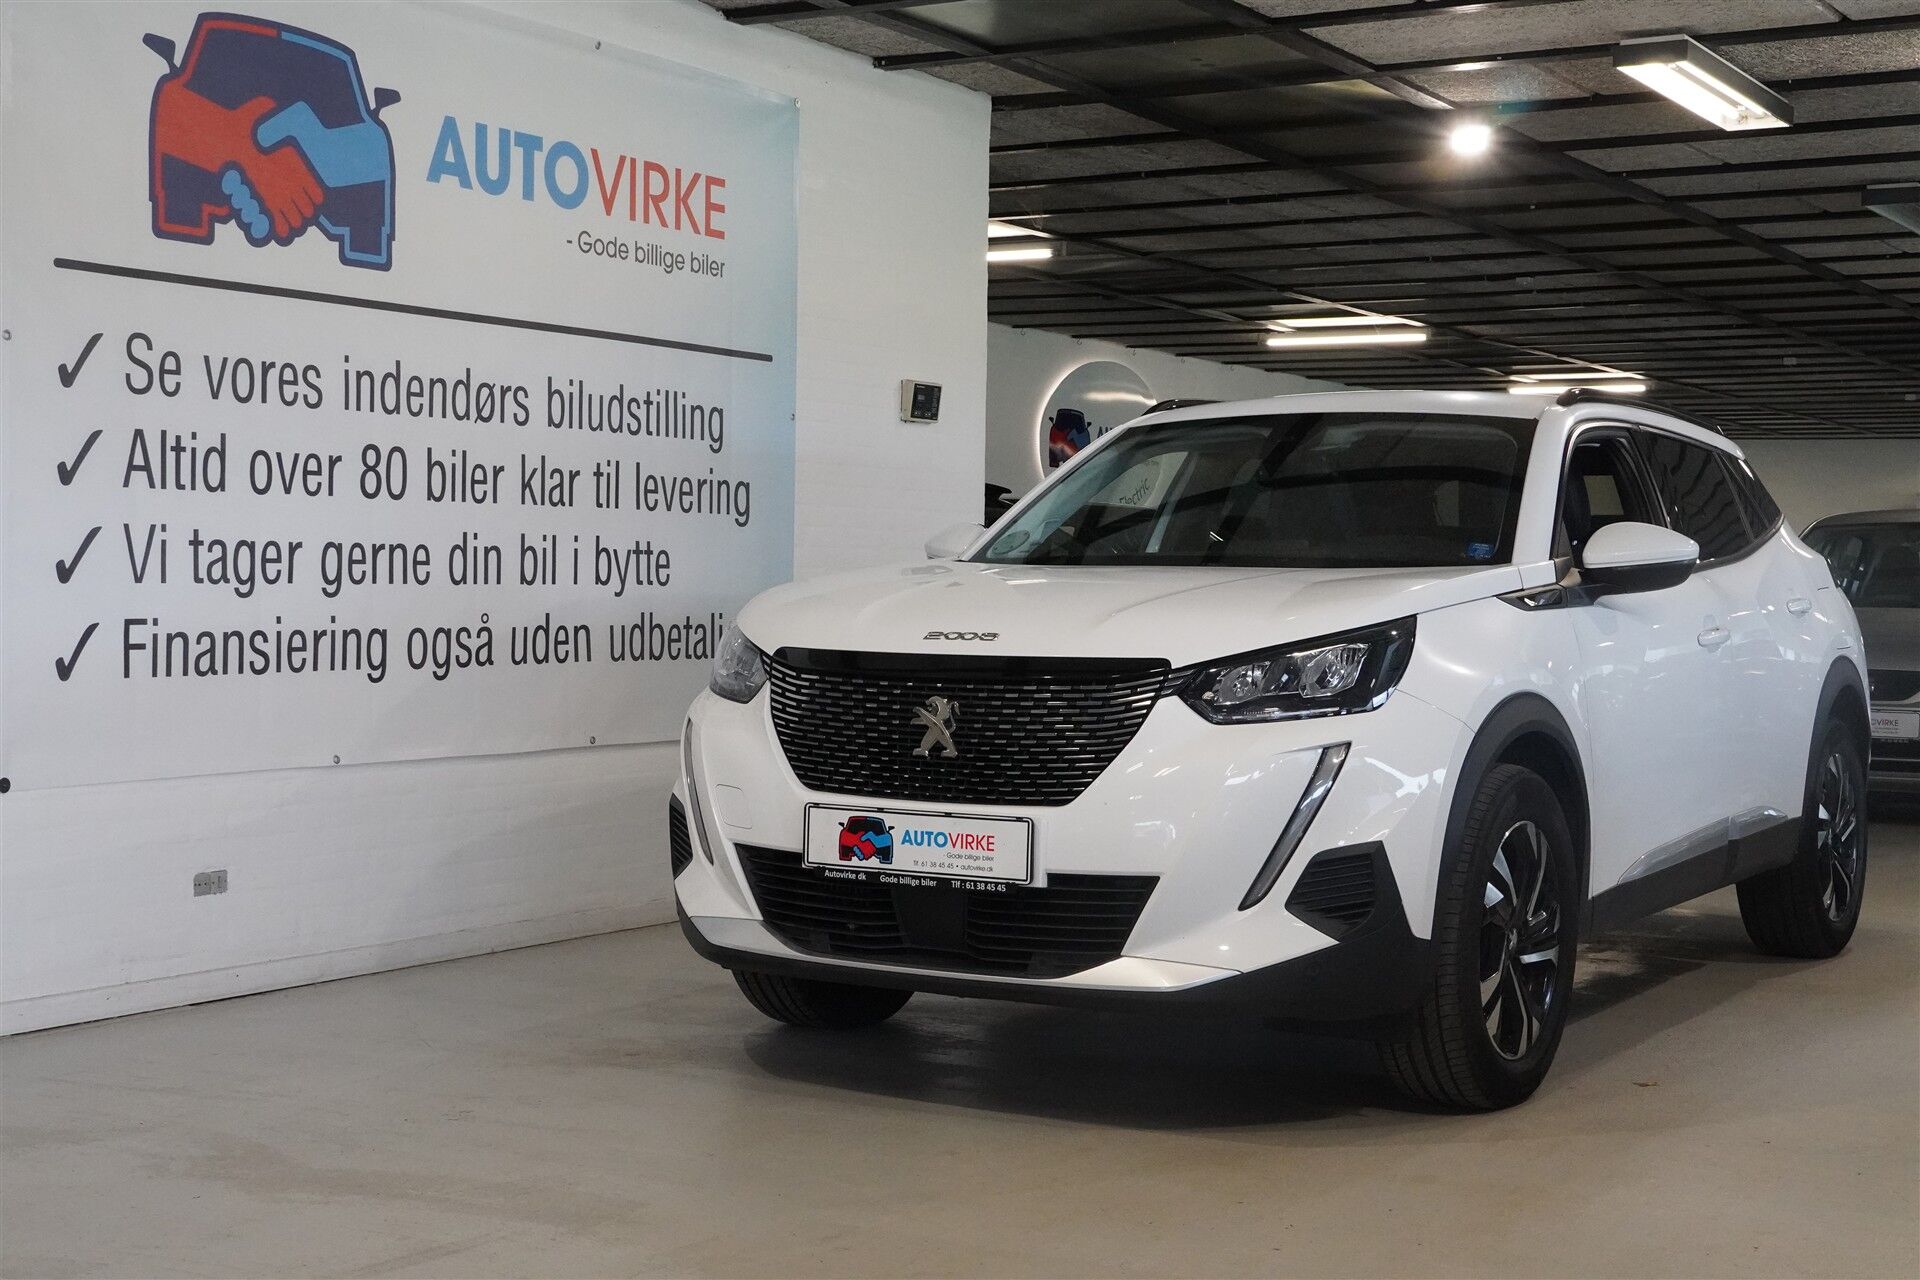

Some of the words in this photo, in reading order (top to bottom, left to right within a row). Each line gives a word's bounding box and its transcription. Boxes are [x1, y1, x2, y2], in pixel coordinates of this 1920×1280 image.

[427, 116, 726, 240] AUTOVIRKE
[577, 230, 629, 261] Gode
[634, 240, 685, 275] billige
[690, 251, 726, 278] biler
[123, 332, 182, 398] Se
[203, 354, 323, 411] vores
[344, 354, 530, 427] indendørs
[547, 376, 724, 454] biludstilling
[123, 428, 227, 493] Altid
[249, 450, 342, 500] over
[359, 443, 408, 501] 80
[426, 447, 505, 505] biler
[521, 453, 581, 510] klar
[592, 460, 620, 511] til
[635, 461, 751, 528] levering
[123, 523, 167, 584] Vi
[188, 528, 303, 599] tager
[320, 541, 431, 599] gerne
[448, 531, 502, 586] din
[519, 533, 557, 587] bil
[573, 535, 579, 585] i
[594, 535, 671, 598] bytte
[123, 615, 388, 684] Finansiering
[407, 612, 495, 682] også
[510, 612, 592, 668] uden
[923, 631, 1000, 641] 2008
[901, 829, 995, 852] AUTOVIRKE
[946, 852, 963, 860] Gode
[880, 874, 899, 884] Gode
[899, 876, 920, 887] billige
[921, 878, 937, 887] biler
[965, 881, 975, 890] 61
[976, 882, 985, 891] 38
[986, 883, 996, 892] 45
[996, 884, 1007, 892] 45
